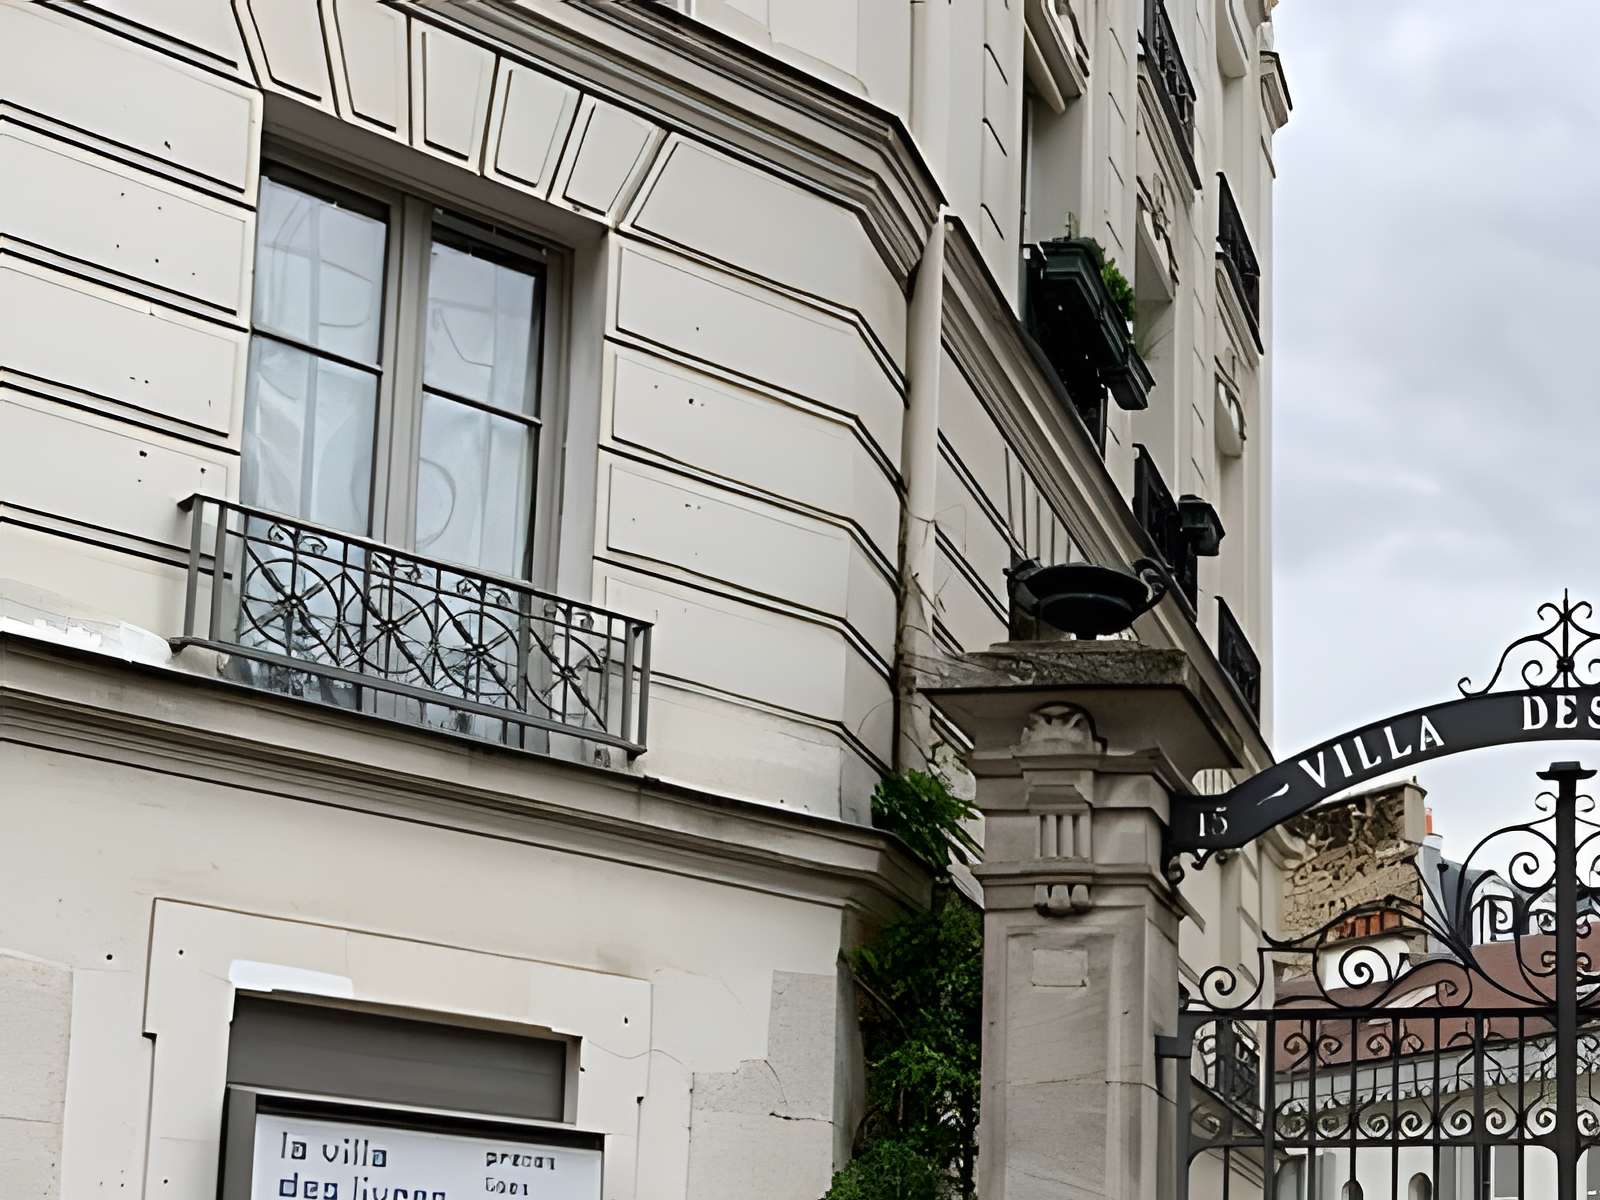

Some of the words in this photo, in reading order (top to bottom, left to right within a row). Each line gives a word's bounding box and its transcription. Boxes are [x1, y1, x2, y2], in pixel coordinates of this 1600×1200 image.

[1298, 715, 1445, 789] VILLA
[1199, 806, 1229, 837] 15
[281, 1131, 307, 1160] la
[322, 1138, 387, 1167] villa
